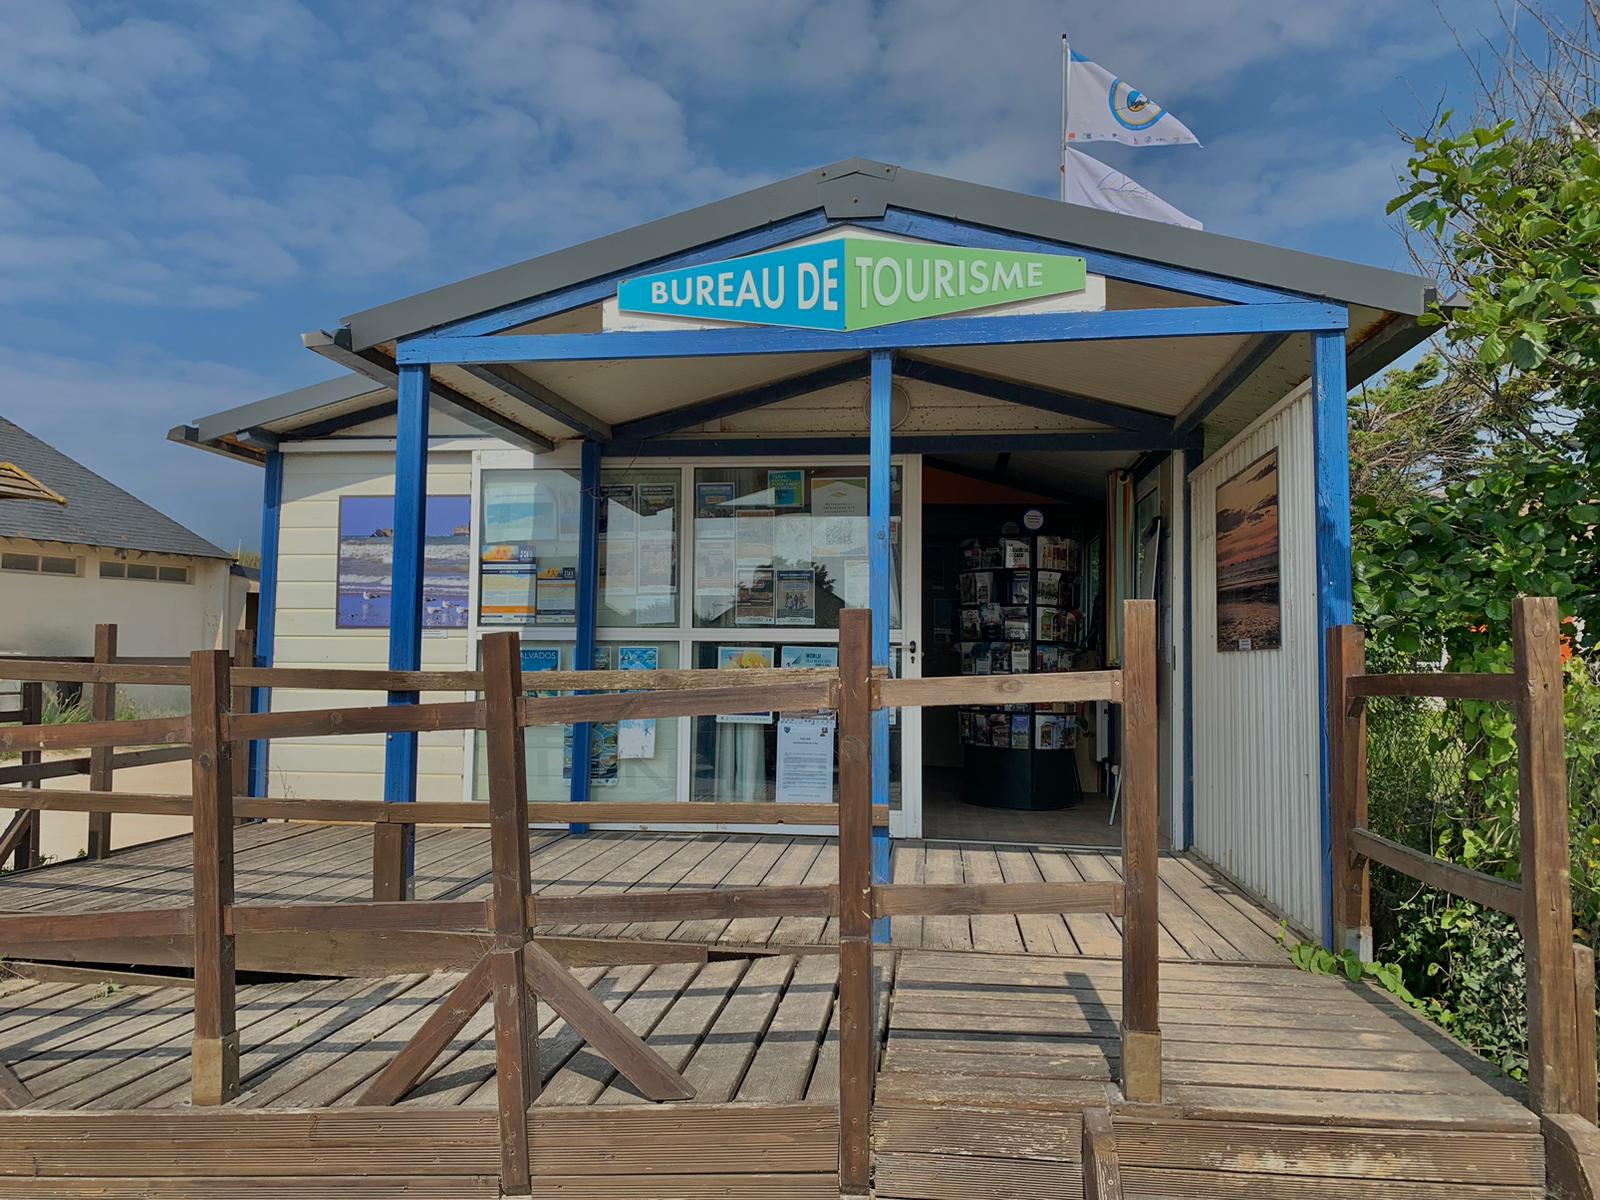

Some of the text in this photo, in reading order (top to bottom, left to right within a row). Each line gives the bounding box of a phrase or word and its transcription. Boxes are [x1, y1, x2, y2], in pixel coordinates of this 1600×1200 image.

[651, 256, 1044, 311] BUREAU DE TOURISME
[521, 651, 556, 660] ALVADOS
